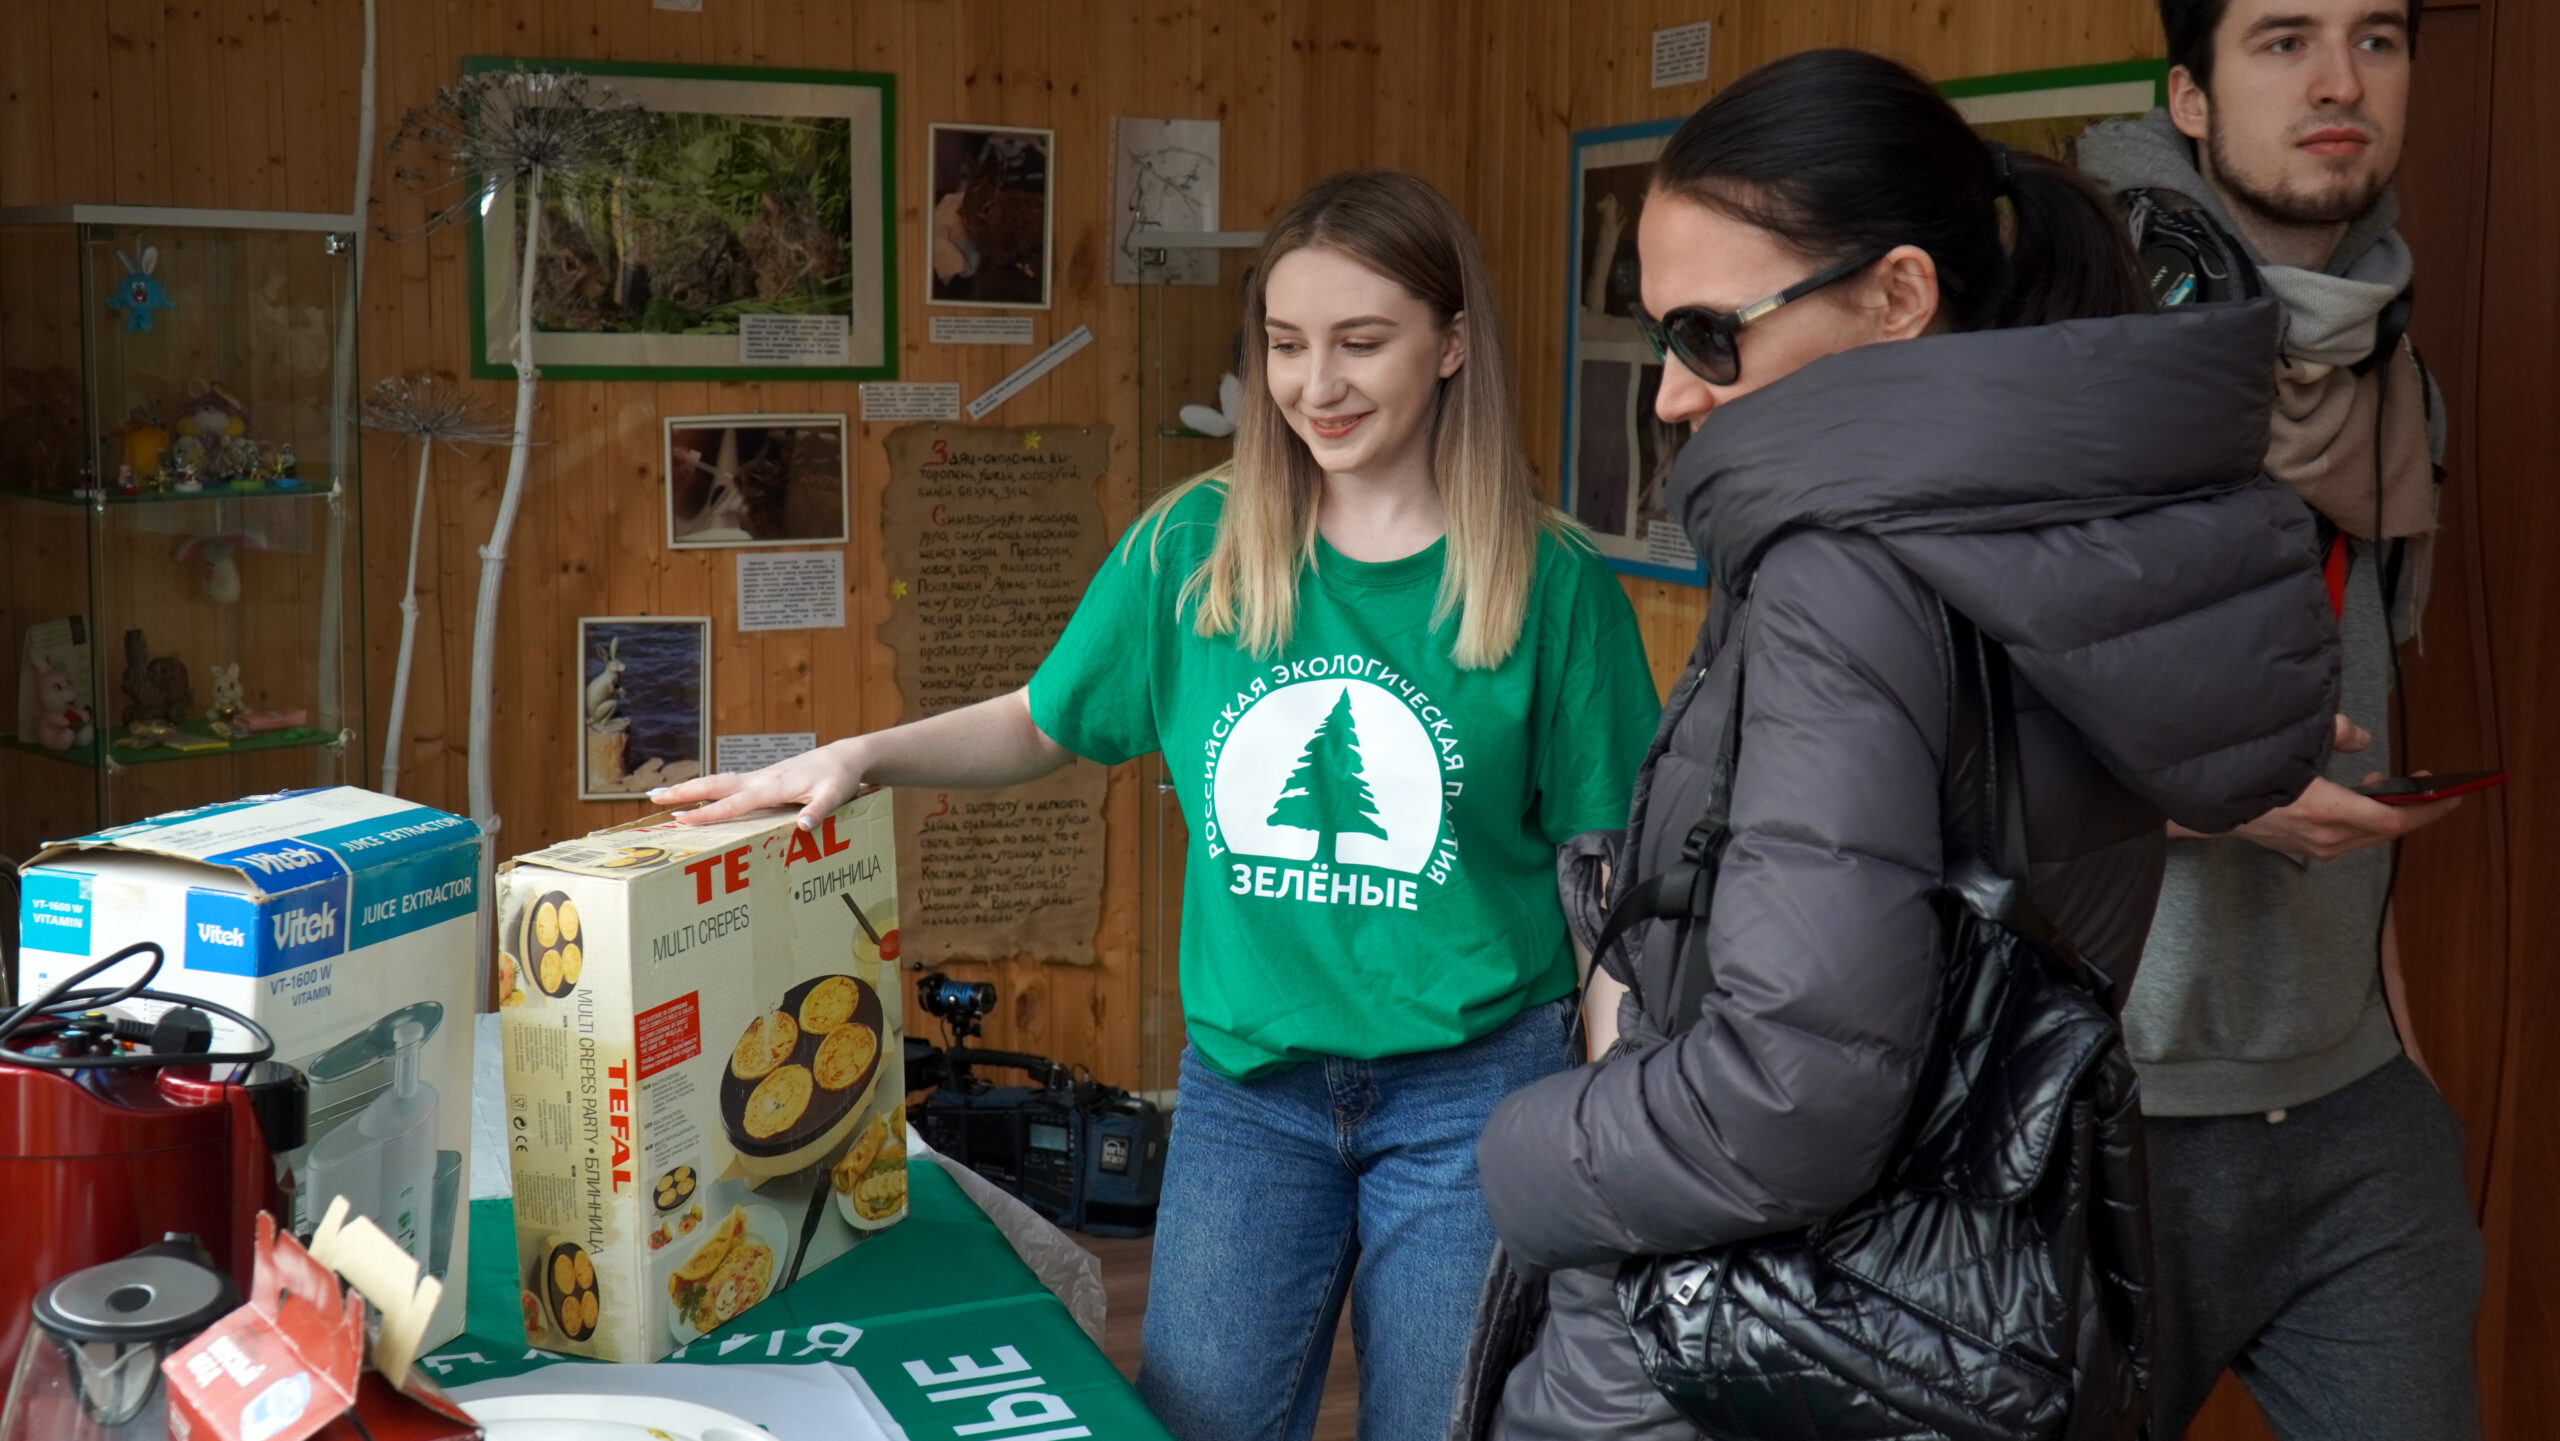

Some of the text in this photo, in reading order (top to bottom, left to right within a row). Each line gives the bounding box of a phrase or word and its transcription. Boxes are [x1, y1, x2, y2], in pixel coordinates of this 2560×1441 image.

[1204, 677, 1268, 859] РОССИЙСКАЯ
[1271, 654, 1465, 772] ЭКОЛОГИЧЕСКАЯ
[339, 832, 380, 853] JUICE
[382, 815, 463, 844] EXTRACTOR
[238, 846, 322, 877] Vitek
[684, 814, 851, 905] TEAL
[802, 854, 882, 904] БЛИННИЦА
[361, 876, 472, 927] JUICE EXTRACTOR
[1229, 862, 1418, 911] ЗЕЛЁНЫЕ
[33, 913, 84, 929] VITAMIN
[198, 922, 245, 948] Vitek
[272, 902, 337, 950] Vitek
[652, 904, 750, 963] MULTI CREPES
[270, 964, 332, 996] VT-1600 W
[292, 984, 332, 1008] VITAMIN
[577, 988, 599, 1145] MULTI CREPES PARTY
[607, 1059, 631, 1194] TEFAL
[584, 1157, 603, 1255] БЛИННИЦА
